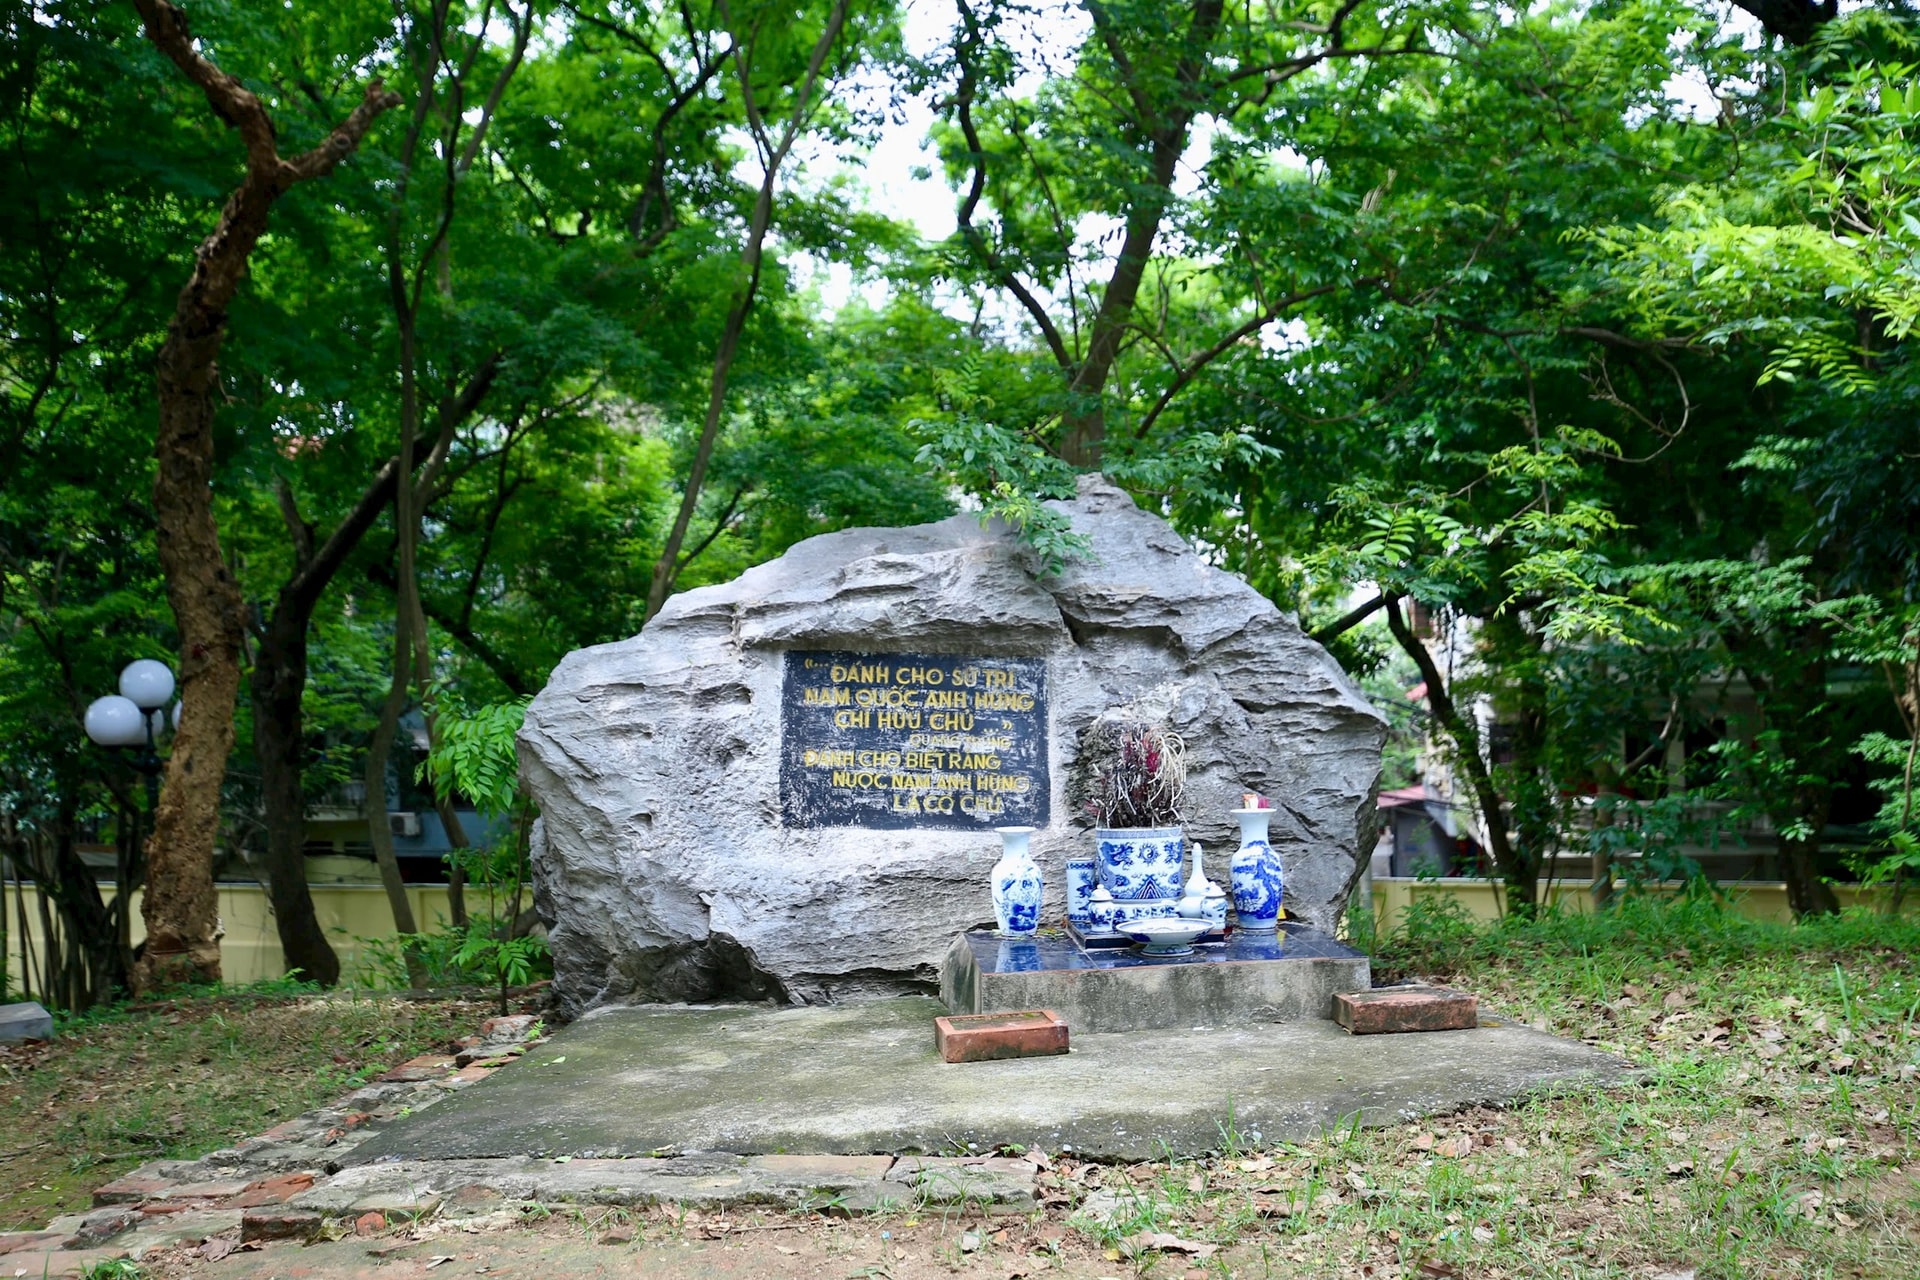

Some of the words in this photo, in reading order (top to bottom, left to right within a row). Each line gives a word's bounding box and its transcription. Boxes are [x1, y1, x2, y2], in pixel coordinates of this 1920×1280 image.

[830, 661, 889, 684] ĐÁNH
[896, 667, 944, 685] CHO
[804, 686, 850, 706] NAM
[856, 685, 919, 707] QUỐC
[925, 690, 967, 709] ANH
[834, 709, 870, 729] CHI
[929, 709, 974, 731] CHỦ
[858, 750, 901, 767] CHO
[905, 747, 946, 769] BIẾT
[891, 773, 931, 789] NAM
[936, 774, 972, 791] ANH
